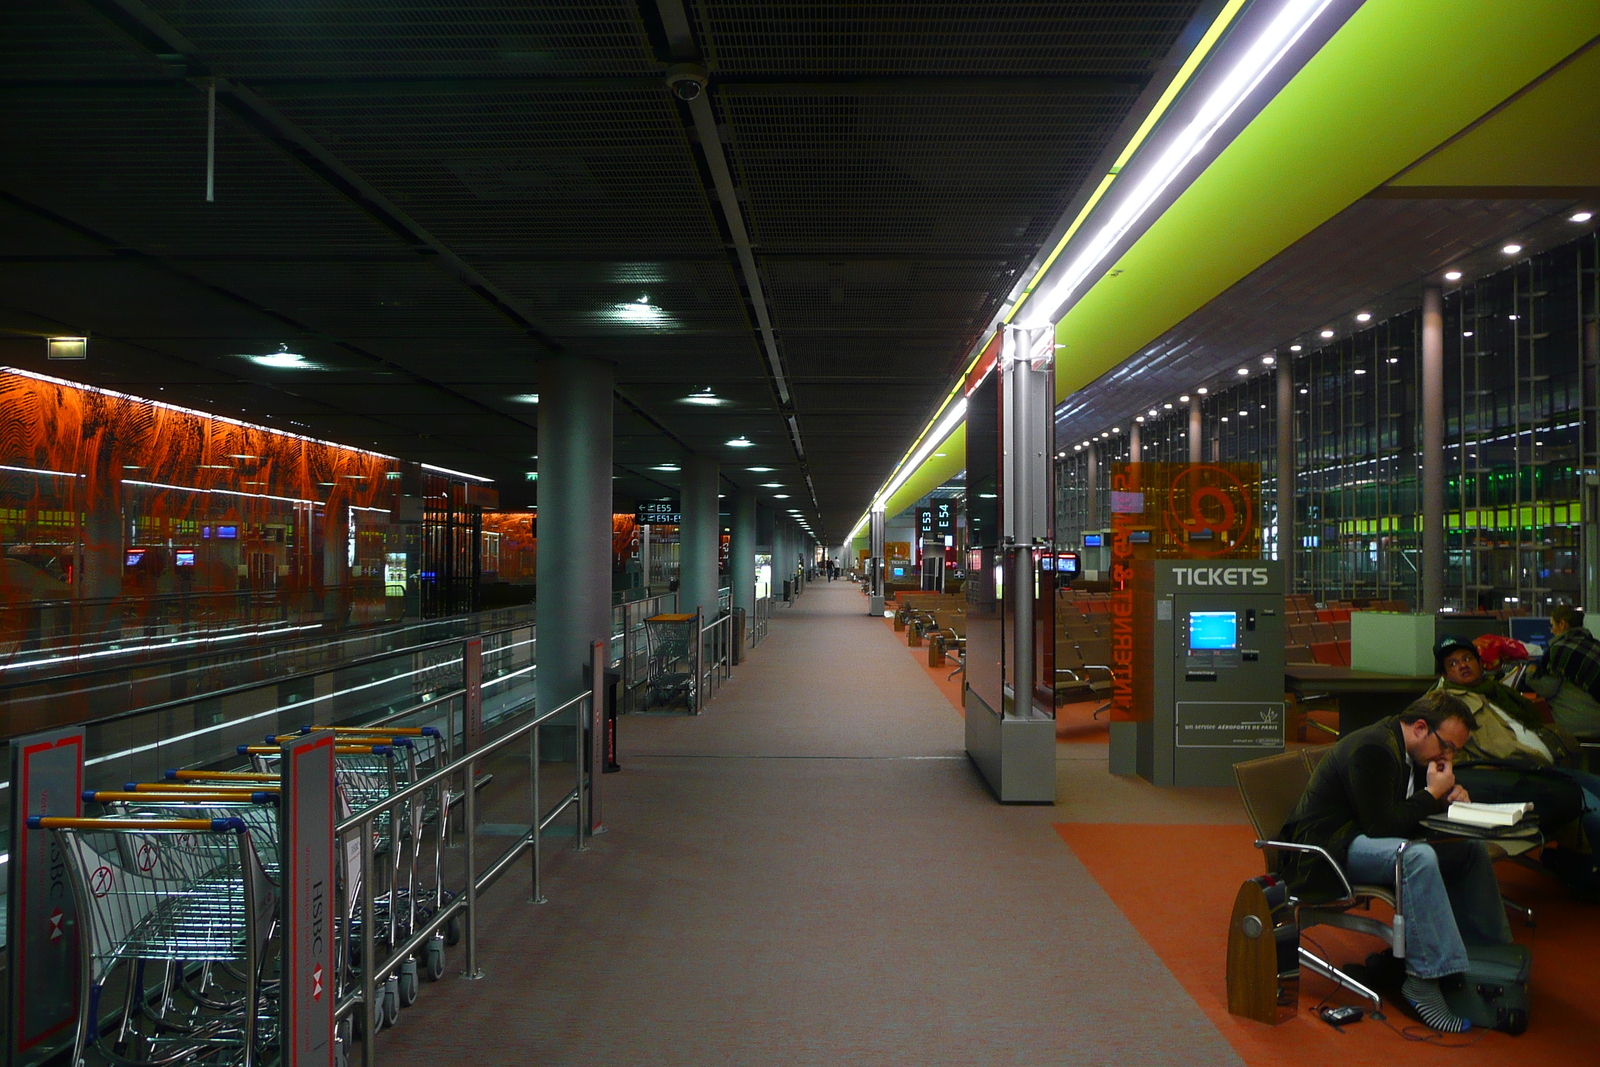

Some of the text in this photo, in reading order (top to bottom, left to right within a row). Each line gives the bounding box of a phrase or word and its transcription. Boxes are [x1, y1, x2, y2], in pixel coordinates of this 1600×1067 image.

[656, 504, 672, 512] E55
[939, 504, 948, 518] 54
[923, 512, 931, 524] 53
[1172, 567, 1269, 586] TICKETS
[312, 880, 323, 957] HSBC
